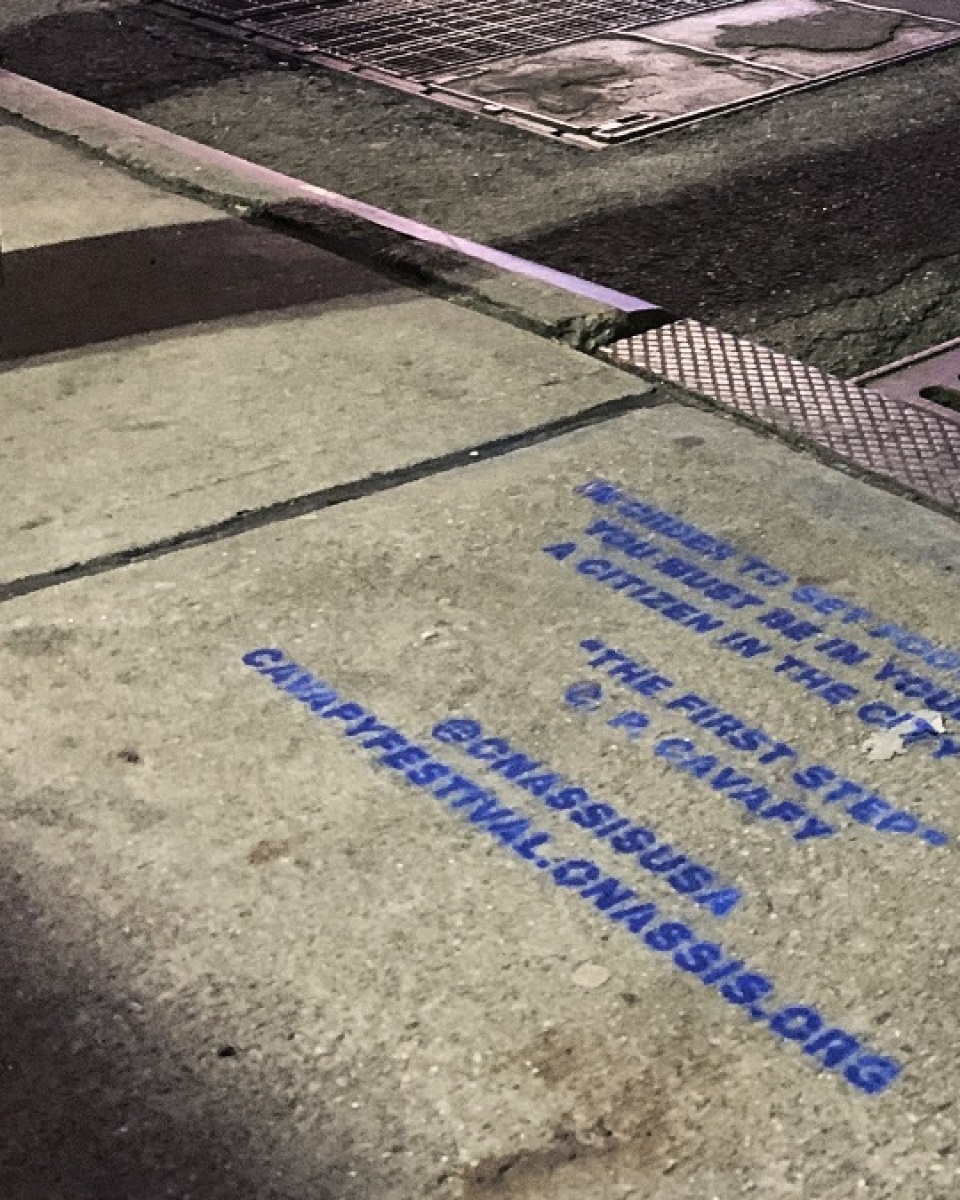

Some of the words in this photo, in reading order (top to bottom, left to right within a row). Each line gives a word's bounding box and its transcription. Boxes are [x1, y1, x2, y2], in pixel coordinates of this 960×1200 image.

[541, 540, 577, 563] A
[576, 557, 725, 634] CITIZEN
[718, 631, 774, 658] IN
[774, 653, 860, 705] THE
[585, 519, 658, 560] YOU
[654, 556, 766, 610] MUST
[756, 607, 823, 642] BE
[814, 637, 872, 666] IN
[738, 556, 791, 587] TO
[790, 585, 874, 624] SET
[652, 736, 837, 843] CAVAFY
[666, 692, 798, 766] FIRST
[431, 717, 742, 918] @ONASSISUSA
